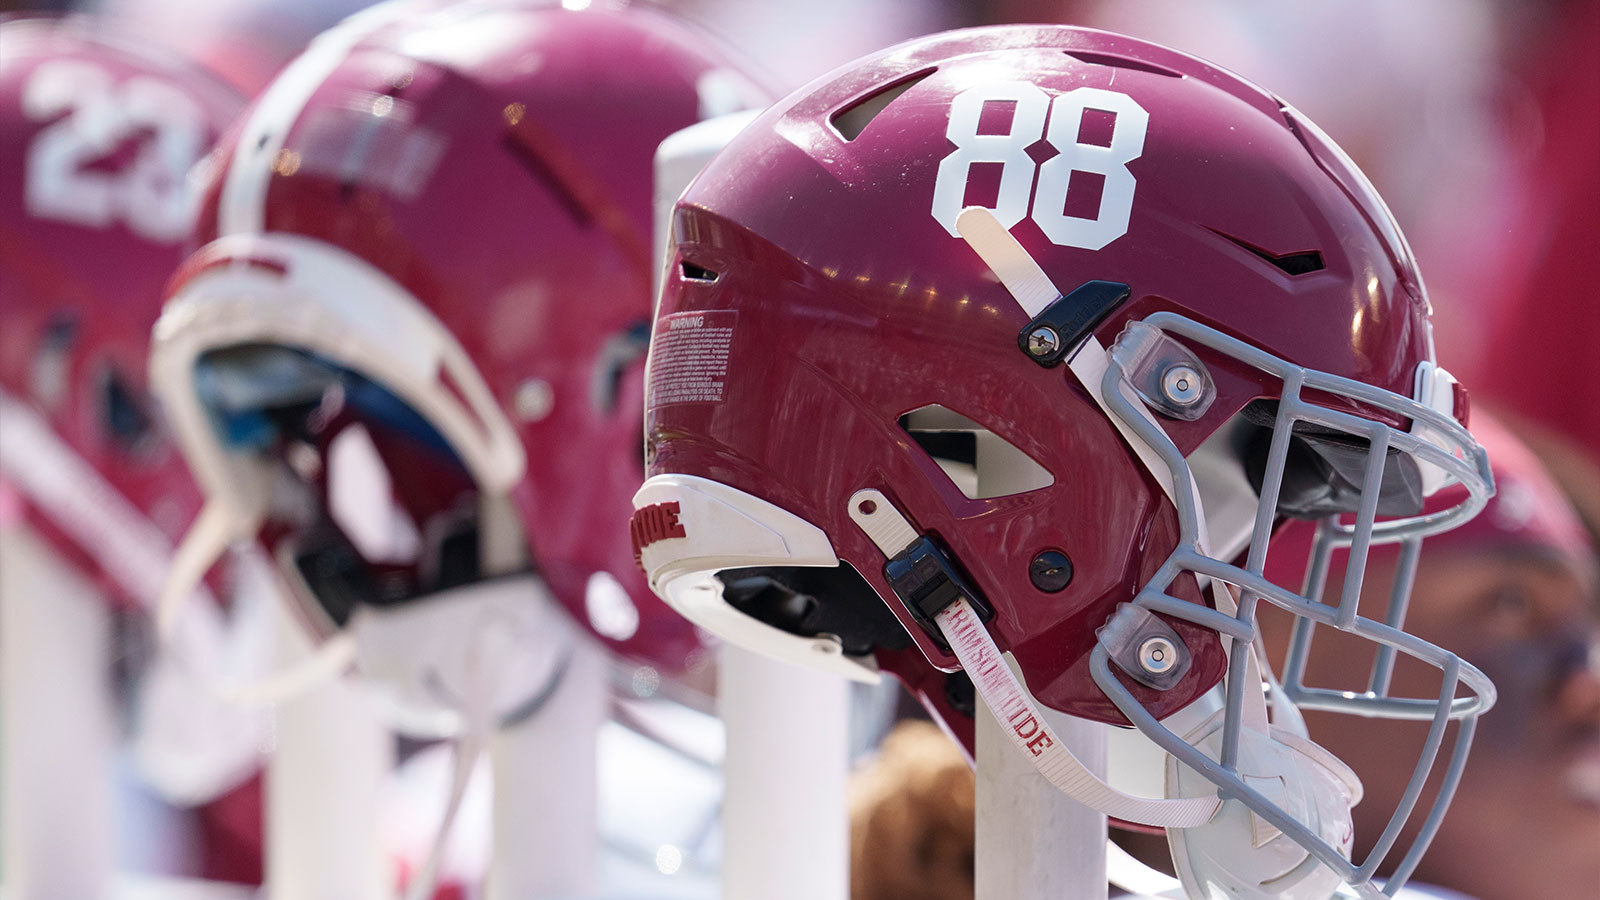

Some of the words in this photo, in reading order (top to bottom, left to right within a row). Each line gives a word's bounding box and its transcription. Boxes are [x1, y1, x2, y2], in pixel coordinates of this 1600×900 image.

[931, 81, 1150, 251] 88
[670, 316, 704, 329] WARNING
[1001, 689, 1054, 757] TIDE
